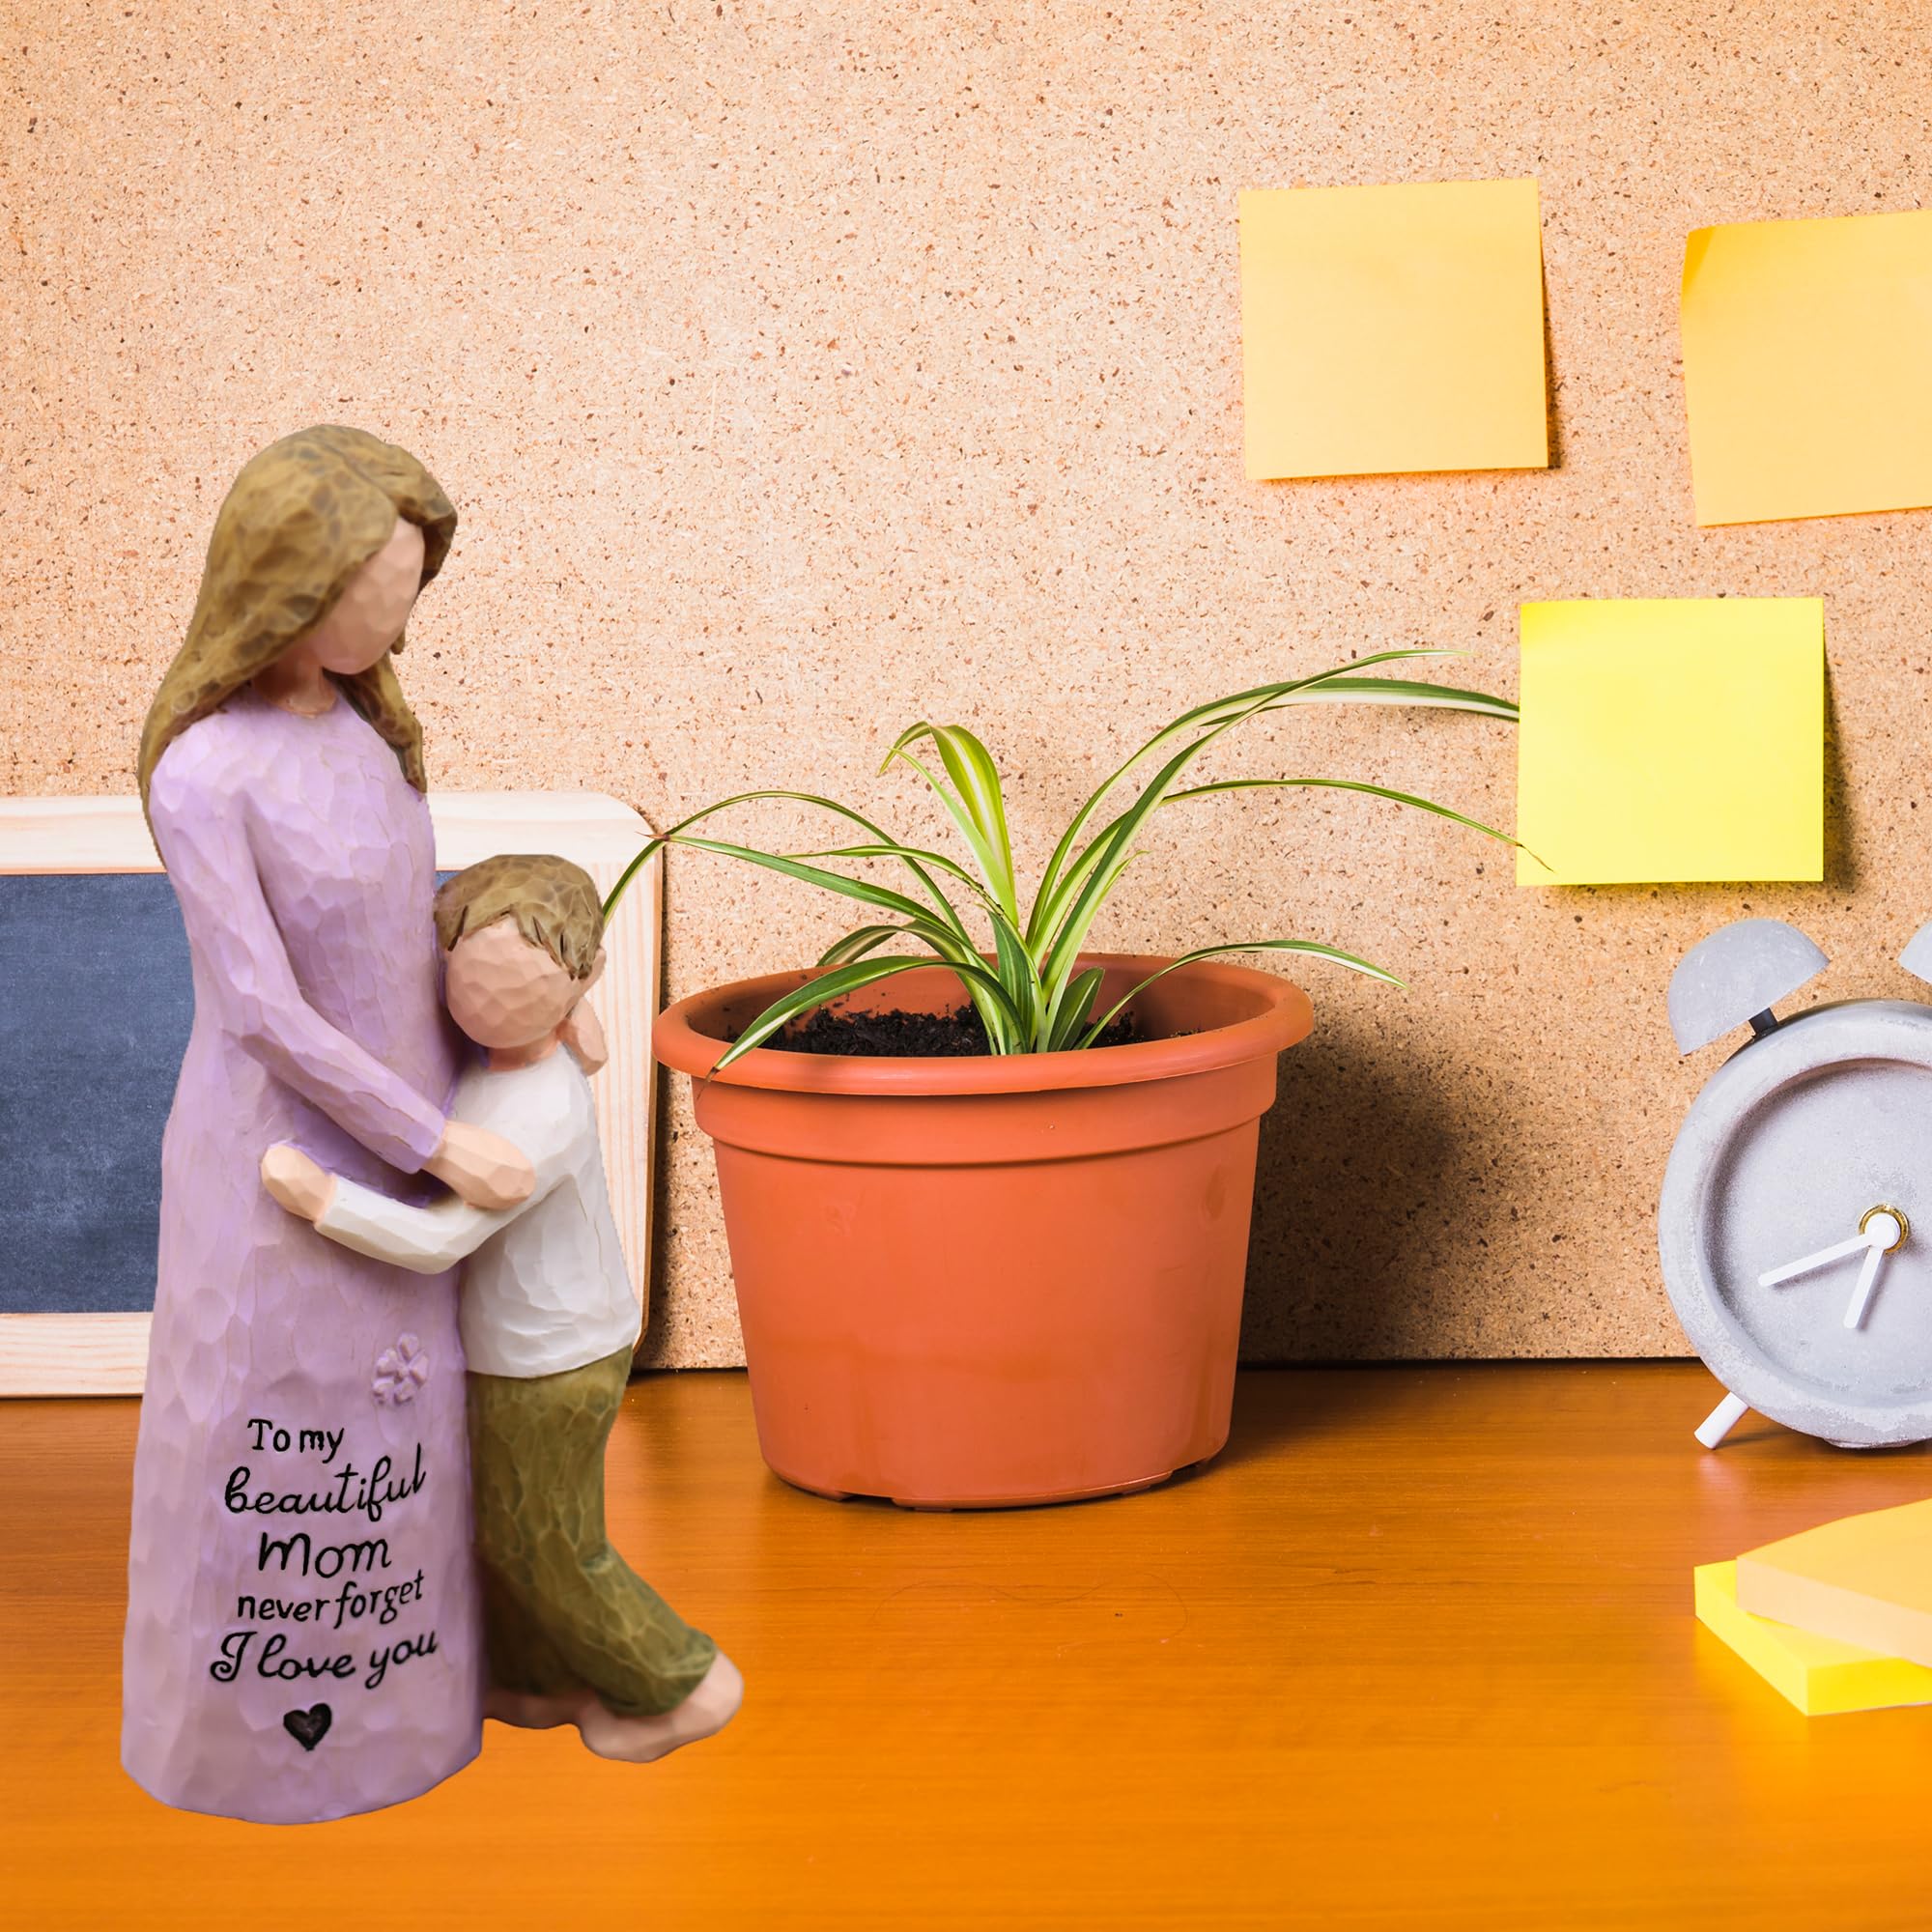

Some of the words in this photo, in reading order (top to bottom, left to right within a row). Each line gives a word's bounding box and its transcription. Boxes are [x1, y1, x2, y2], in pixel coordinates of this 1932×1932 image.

[247, 1418, 291, 1453] To
[298, 1428, 345, 1464] my
[224, 1442, 427, 1522] beautiful
[238, 1595, 331, 1623] never
[332, 1569, 425, 1630] forget
[209, 1631, 258, 1684] I
[257, 1633, 356, 1681] love
[364, 1631, 439, 1690] you
